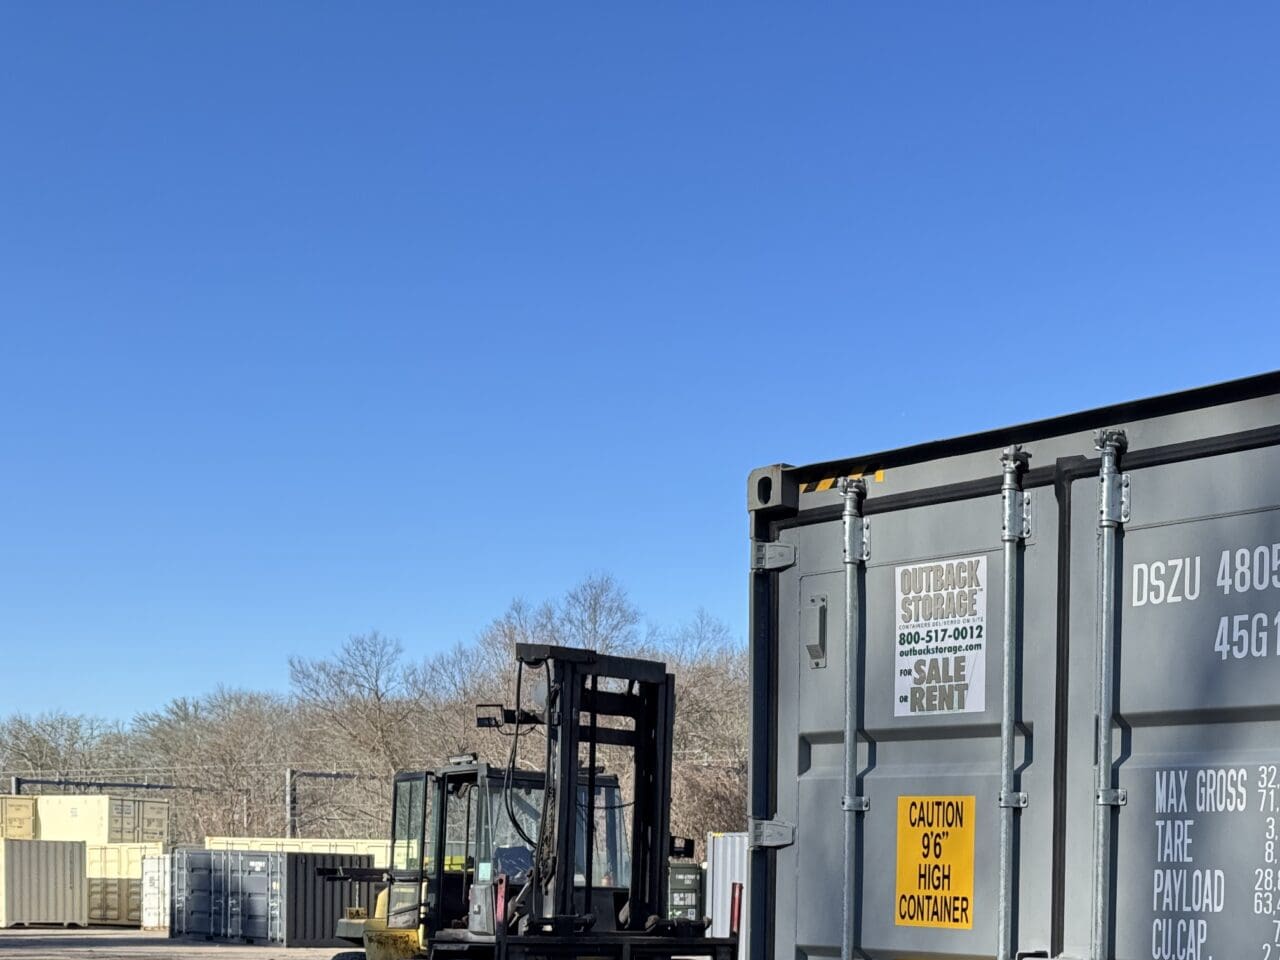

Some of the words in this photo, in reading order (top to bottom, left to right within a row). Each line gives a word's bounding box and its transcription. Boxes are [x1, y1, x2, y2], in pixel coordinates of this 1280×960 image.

[900, 559, 981, 596] OUTBACK
[1132, 555, 1201, 607] DSZU
[900, 589, 978, 624] STORAGE
[899, 622, 931, 630] CONTAINERS
[899, 625, 983, 646] 800-517-0012
[899, 643, 982, 657] outbackstorage.com
[899, 667, 913, 677] FOR
[913, 655, 967, 686] SALE
[899, 694, 909, 703] OR
[910, 683, 969, 713] RENT
[1155, 769, 1188, 813] MAX
[1196, 768, 1248, 812] GROSS
[909, 801, 964, 828] CAUTION
[1155, 819, 1195, 863] TARE
[917, 863, 951, 891] HIGH
[1153, 869, 1225, 913] PAYLOAD
[899, 894, 969, 924] CONTAINER
